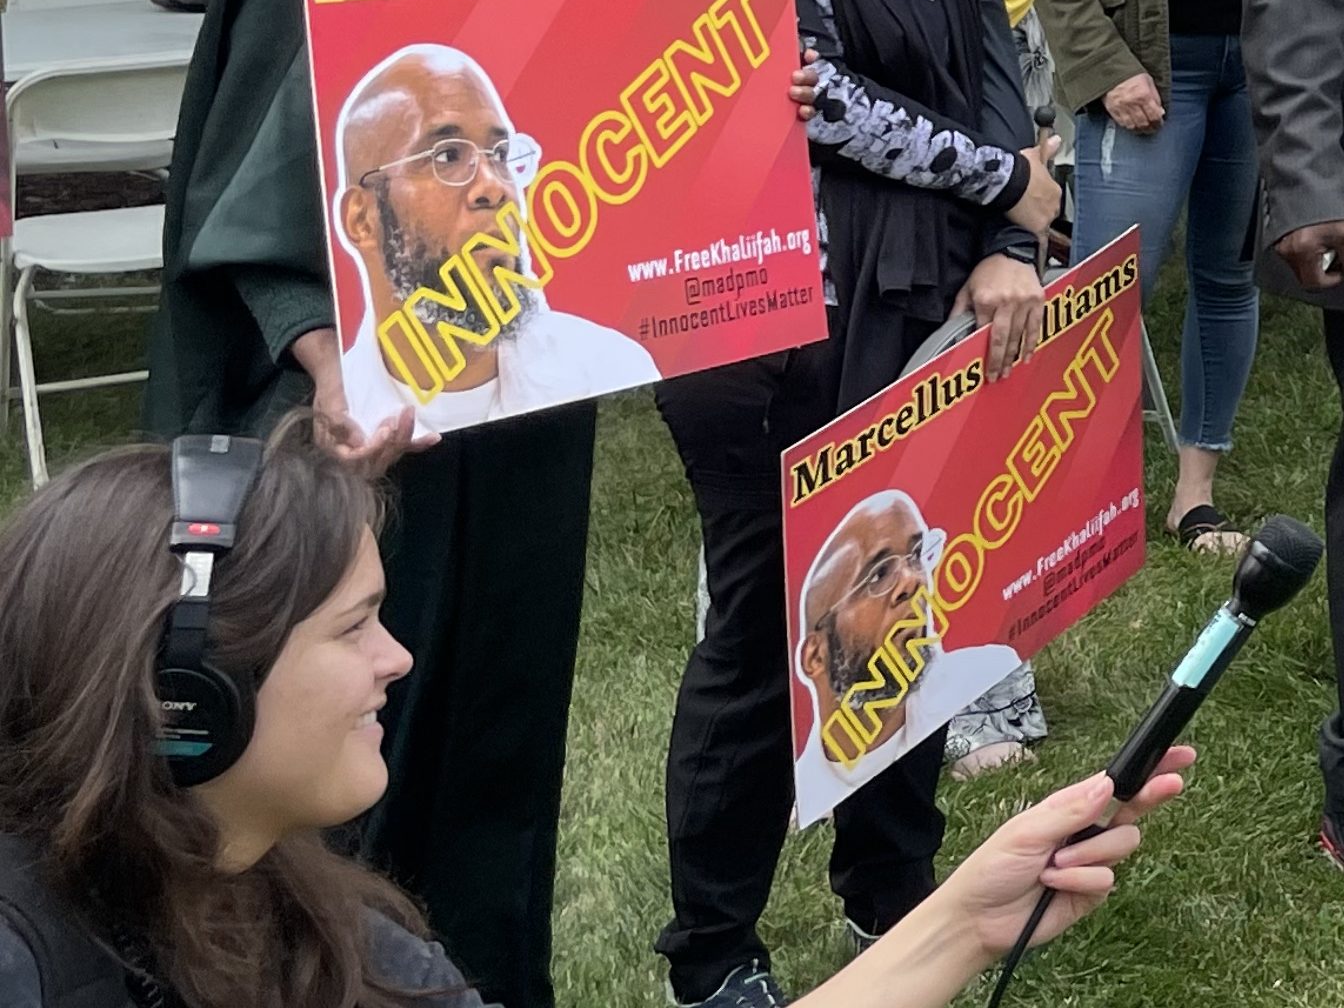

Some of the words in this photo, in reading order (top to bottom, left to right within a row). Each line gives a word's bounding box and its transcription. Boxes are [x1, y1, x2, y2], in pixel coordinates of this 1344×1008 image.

[639, 286, 814, 341] #InnocentLivesMatter
[684, 267, 768, 306] @madpmo
[790, 355, 983, 506] Marcellus
[1030, 254, 1138, 352] lliams
[821, 307, 1119, 772] INNOCENT
[162, 701, 197, 711] ONY
